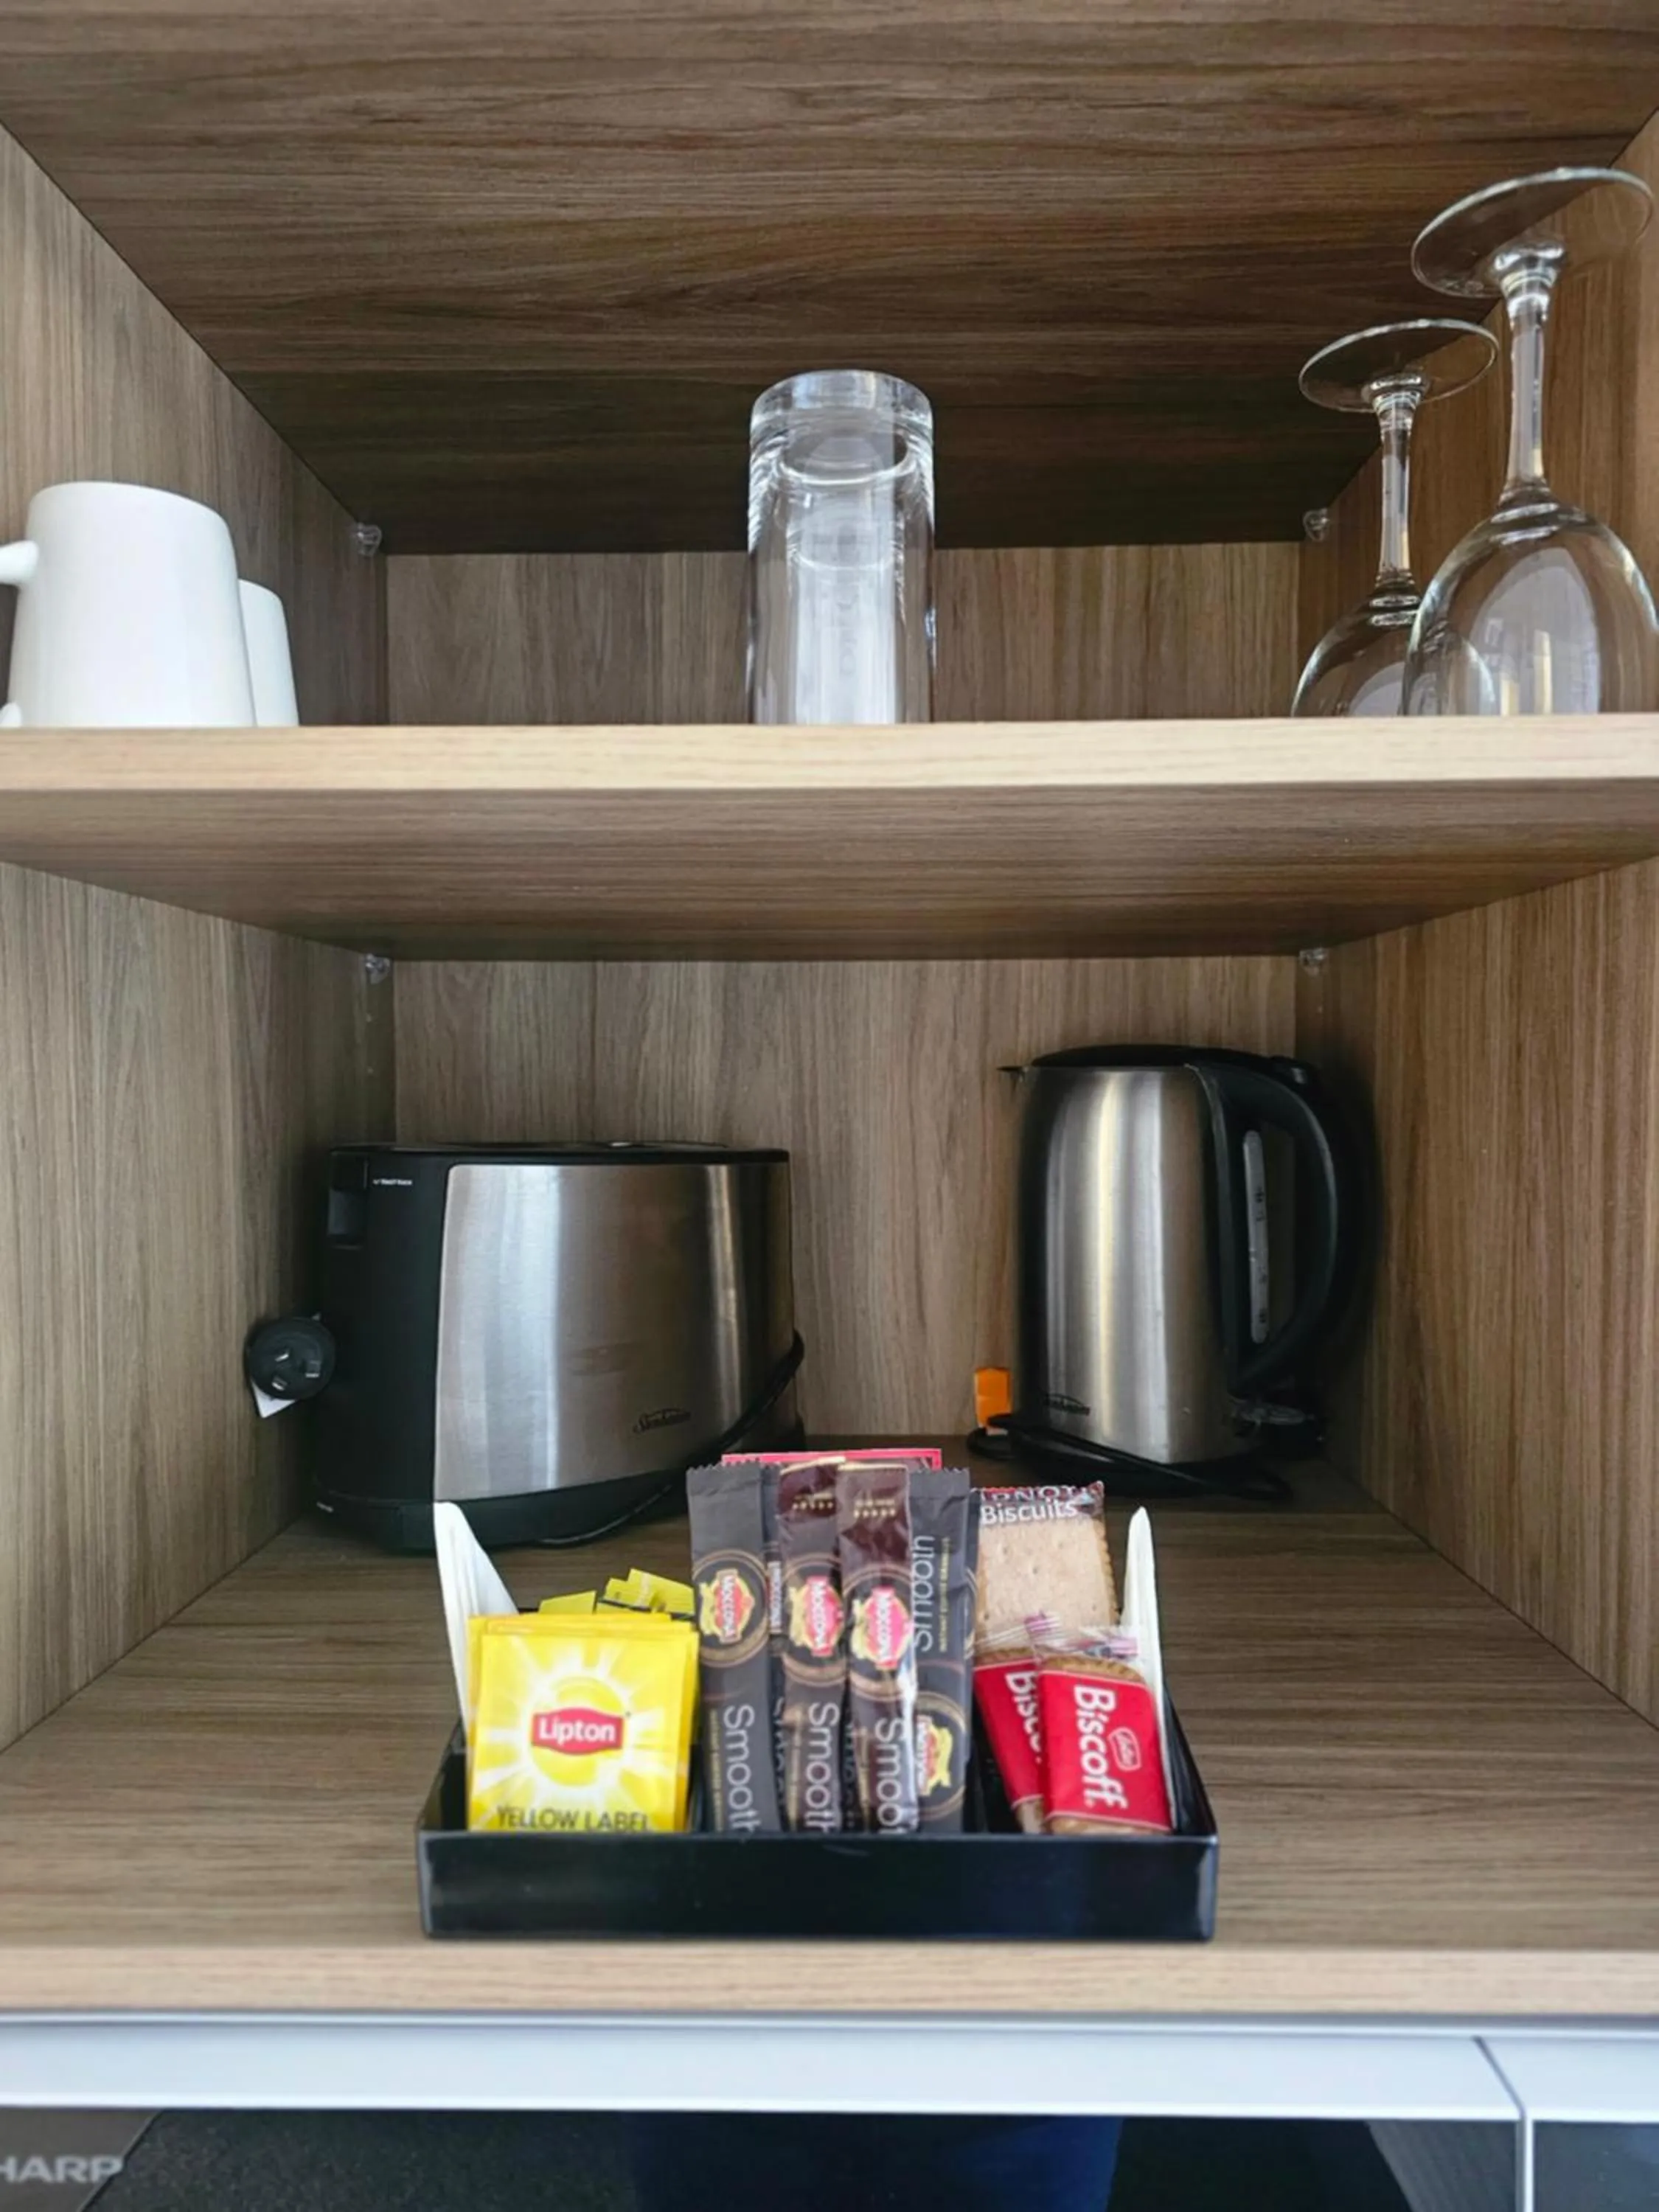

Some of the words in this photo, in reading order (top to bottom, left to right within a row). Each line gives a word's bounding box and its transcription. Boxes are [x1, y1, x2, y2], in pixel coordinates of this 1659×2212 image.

[980, 1498, 1077, 1525] Biscuits
[539, 1717, 616, 1745] Lipton
[496, 1806, 580, 1829] YELLOW
